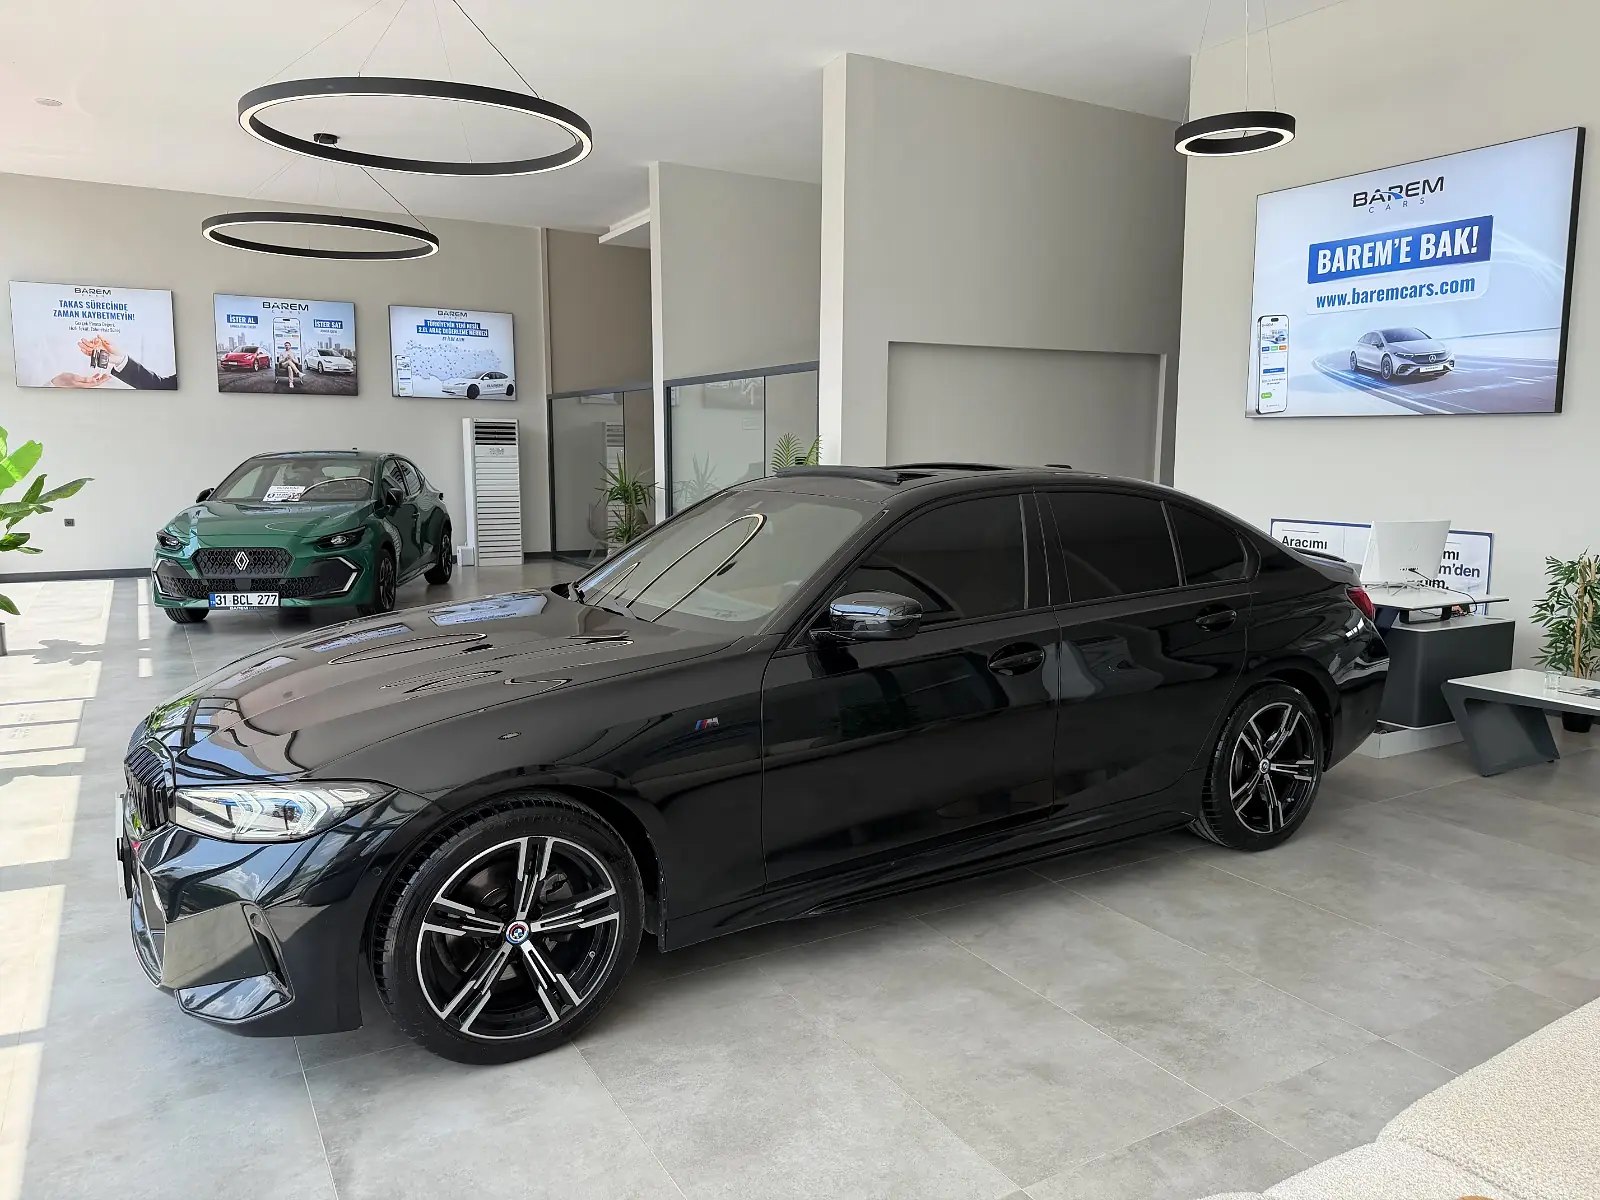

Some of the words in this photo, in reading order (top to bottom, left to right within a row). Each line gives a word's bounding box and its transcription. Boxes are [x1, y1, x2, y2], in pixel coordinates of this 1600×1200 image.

[1353, 176, 1444, 207] BAREM
[1368, 197, 1425, 214] CARS
[1317, 236, 1413, 275] BAREM'E
[1419, 226, 1479, 261] BAK!
[74, 287, 111, 295] BAREM
[1316, 277, 1475, 308] www.baremcars.com
[58, 299, 84, 309] TAKAS
[262, 301, 309, 311] BAREM
[53, 309, 80, 318] ZAMAN
[81, 310, 135, 321] KAYBETMEYİN!
[247, 316, 256, 324] AL
[331, 321, 342, 329] SAT
[1281, 535, 1328, 550] Aracımı
[215, 594, 227, 606] 31
[232, 594, 253, 606] BCL
[257, 594, 278, 605] 277
